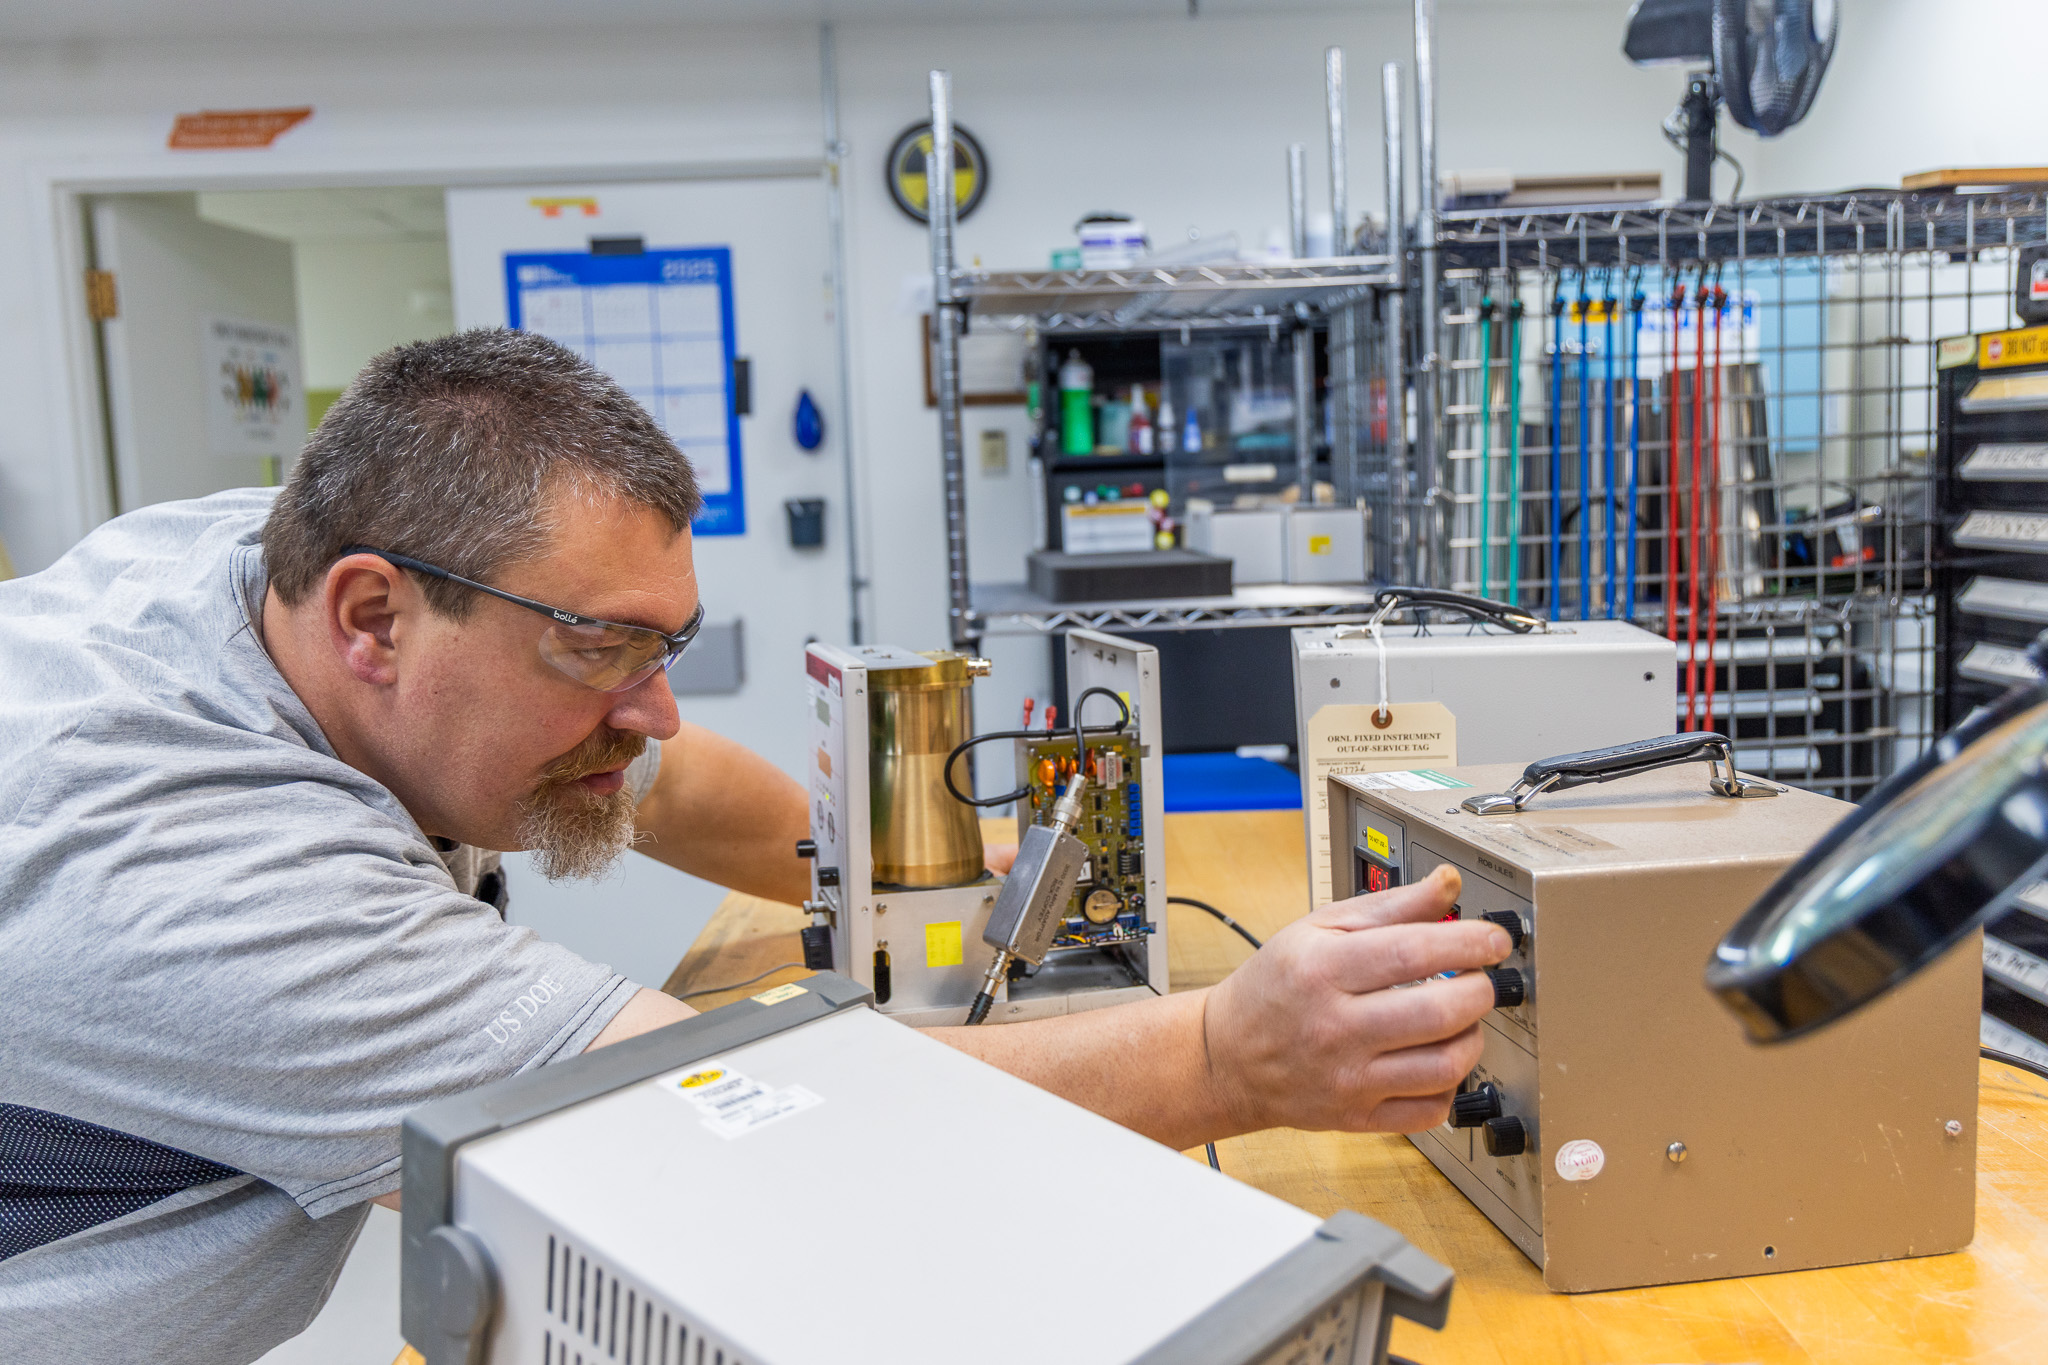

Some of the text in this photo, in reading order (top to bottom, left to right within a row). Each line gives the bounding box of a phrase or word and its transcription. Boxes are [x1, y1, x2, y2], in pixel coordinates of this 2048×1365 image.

[553, 610, 578, 624] bollé
[1327, 732, 1442, 743] ORNL FIXED INSTRUMENT
[1337, 744, 1430, 753] OUT-OF-SERVICE TAG
[1477, 856, 1514, 879] ROB LILES
[483, 975, 563, 1044] US DOE
